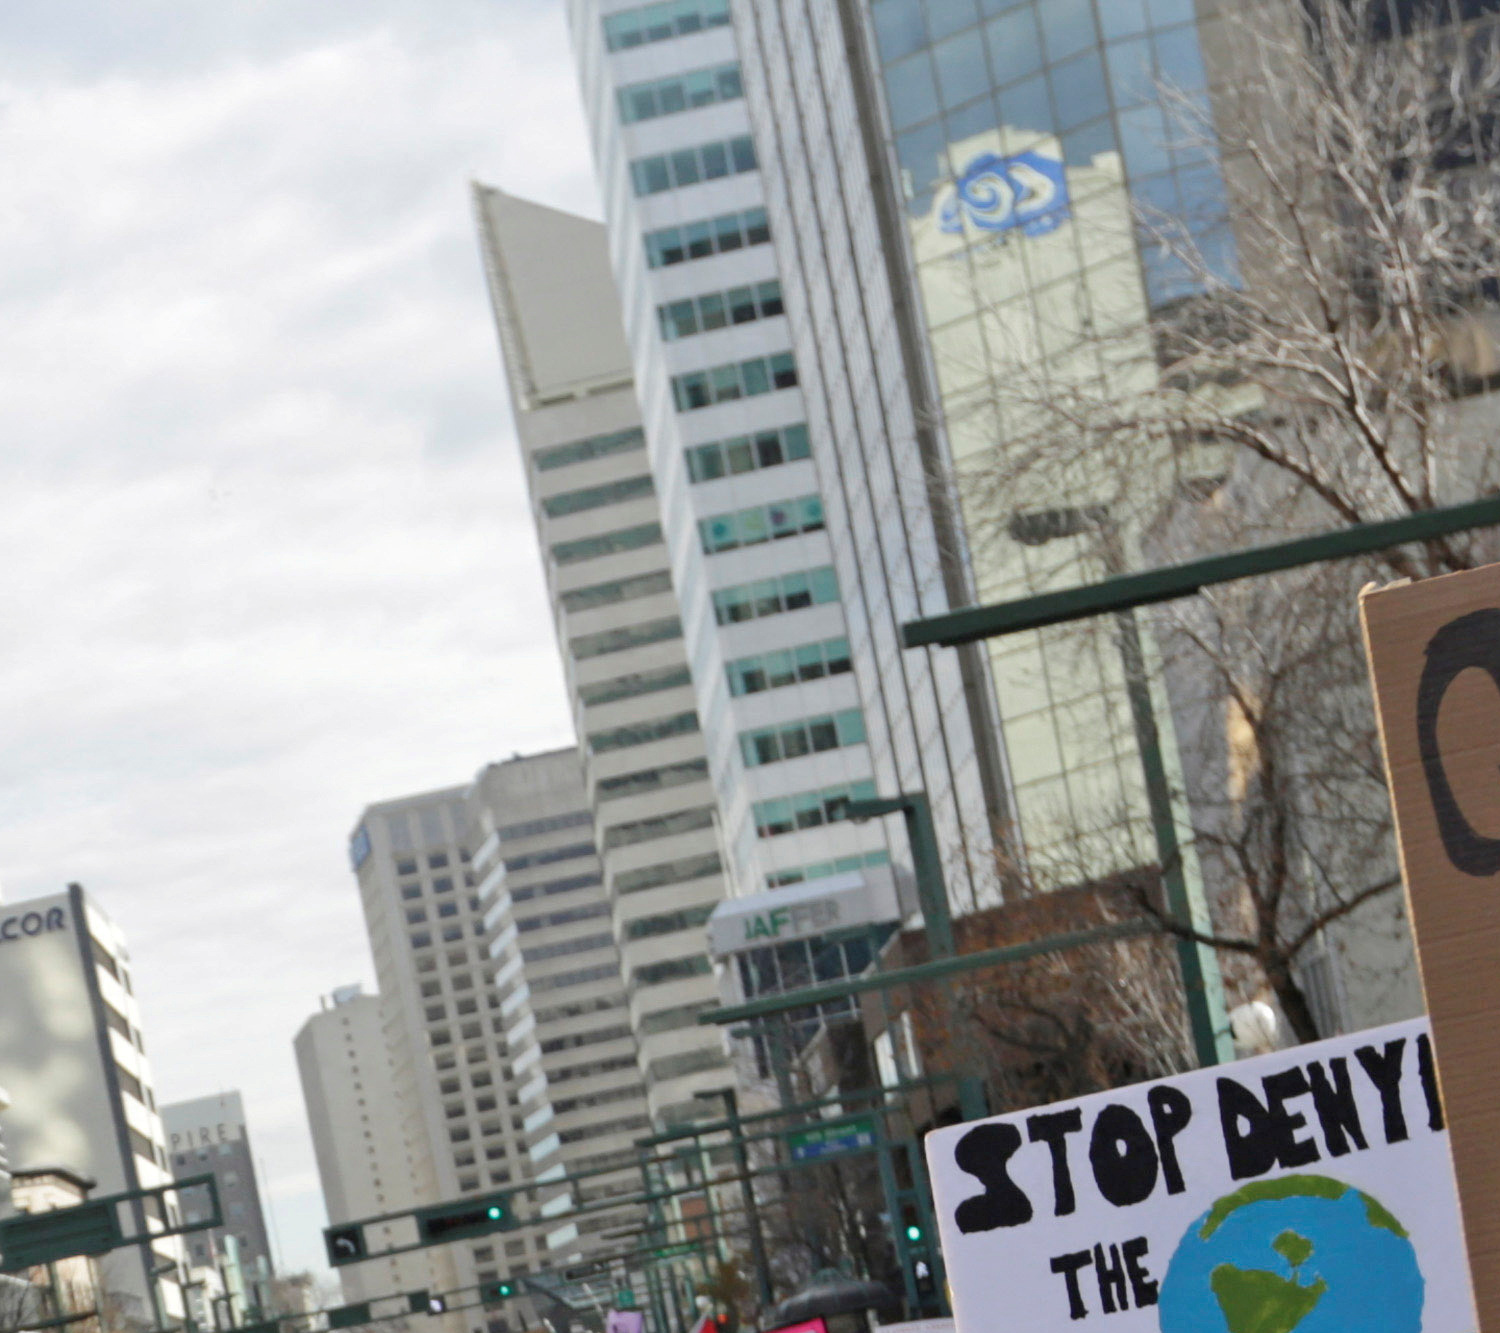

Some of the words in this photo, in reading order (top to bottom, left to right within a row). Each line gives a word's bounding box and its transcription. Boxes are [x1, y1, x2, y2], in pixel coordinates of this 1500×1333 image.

[171, 1123, 227, 1148] PIRE
[954, 1086, 1193, 1234] STOP
[1216, 1034, 1444, 1180] DENYI
[1050, 1236, 1159, 1319] THE
